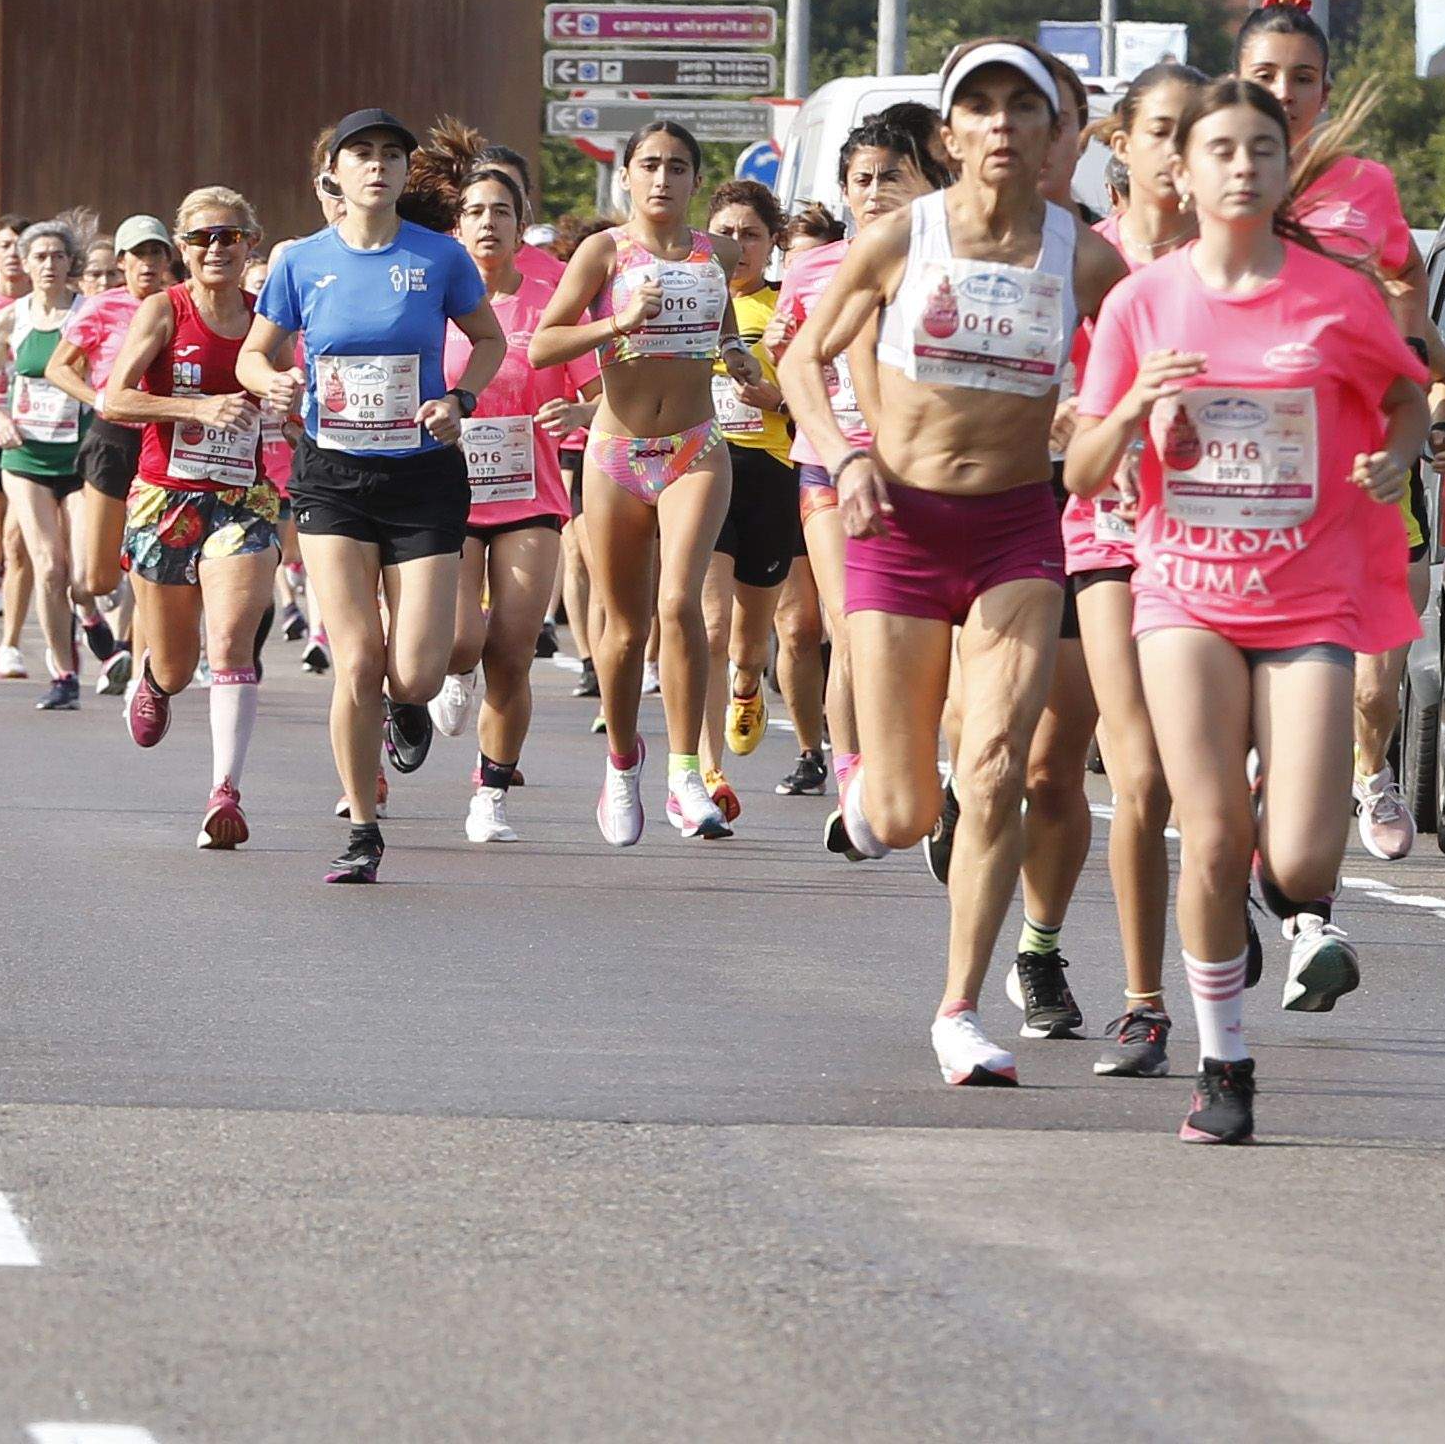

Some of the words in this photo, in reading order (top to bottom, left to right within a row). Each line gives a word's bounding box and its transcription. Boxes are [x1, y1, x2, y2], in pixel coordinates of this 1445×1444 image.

[612, 19, 669, 34] campus
[673, 17, 768, 33] universitaro
[665, 297, 697, 310] 016
[964, 313, 1014, 336] 016
[981, 340, 989, 351] 5
[349, 393, 384, 406] 016
[715, 398, 736, 410] 16
[207, 430, 238, 444] 016
[1208, 440, 1260, 460] 016
[469, 451, 502, 464] 016
[1160, 517, 1309, 554] DORSAL
[1154, 553, 1271, 597] SUMA
